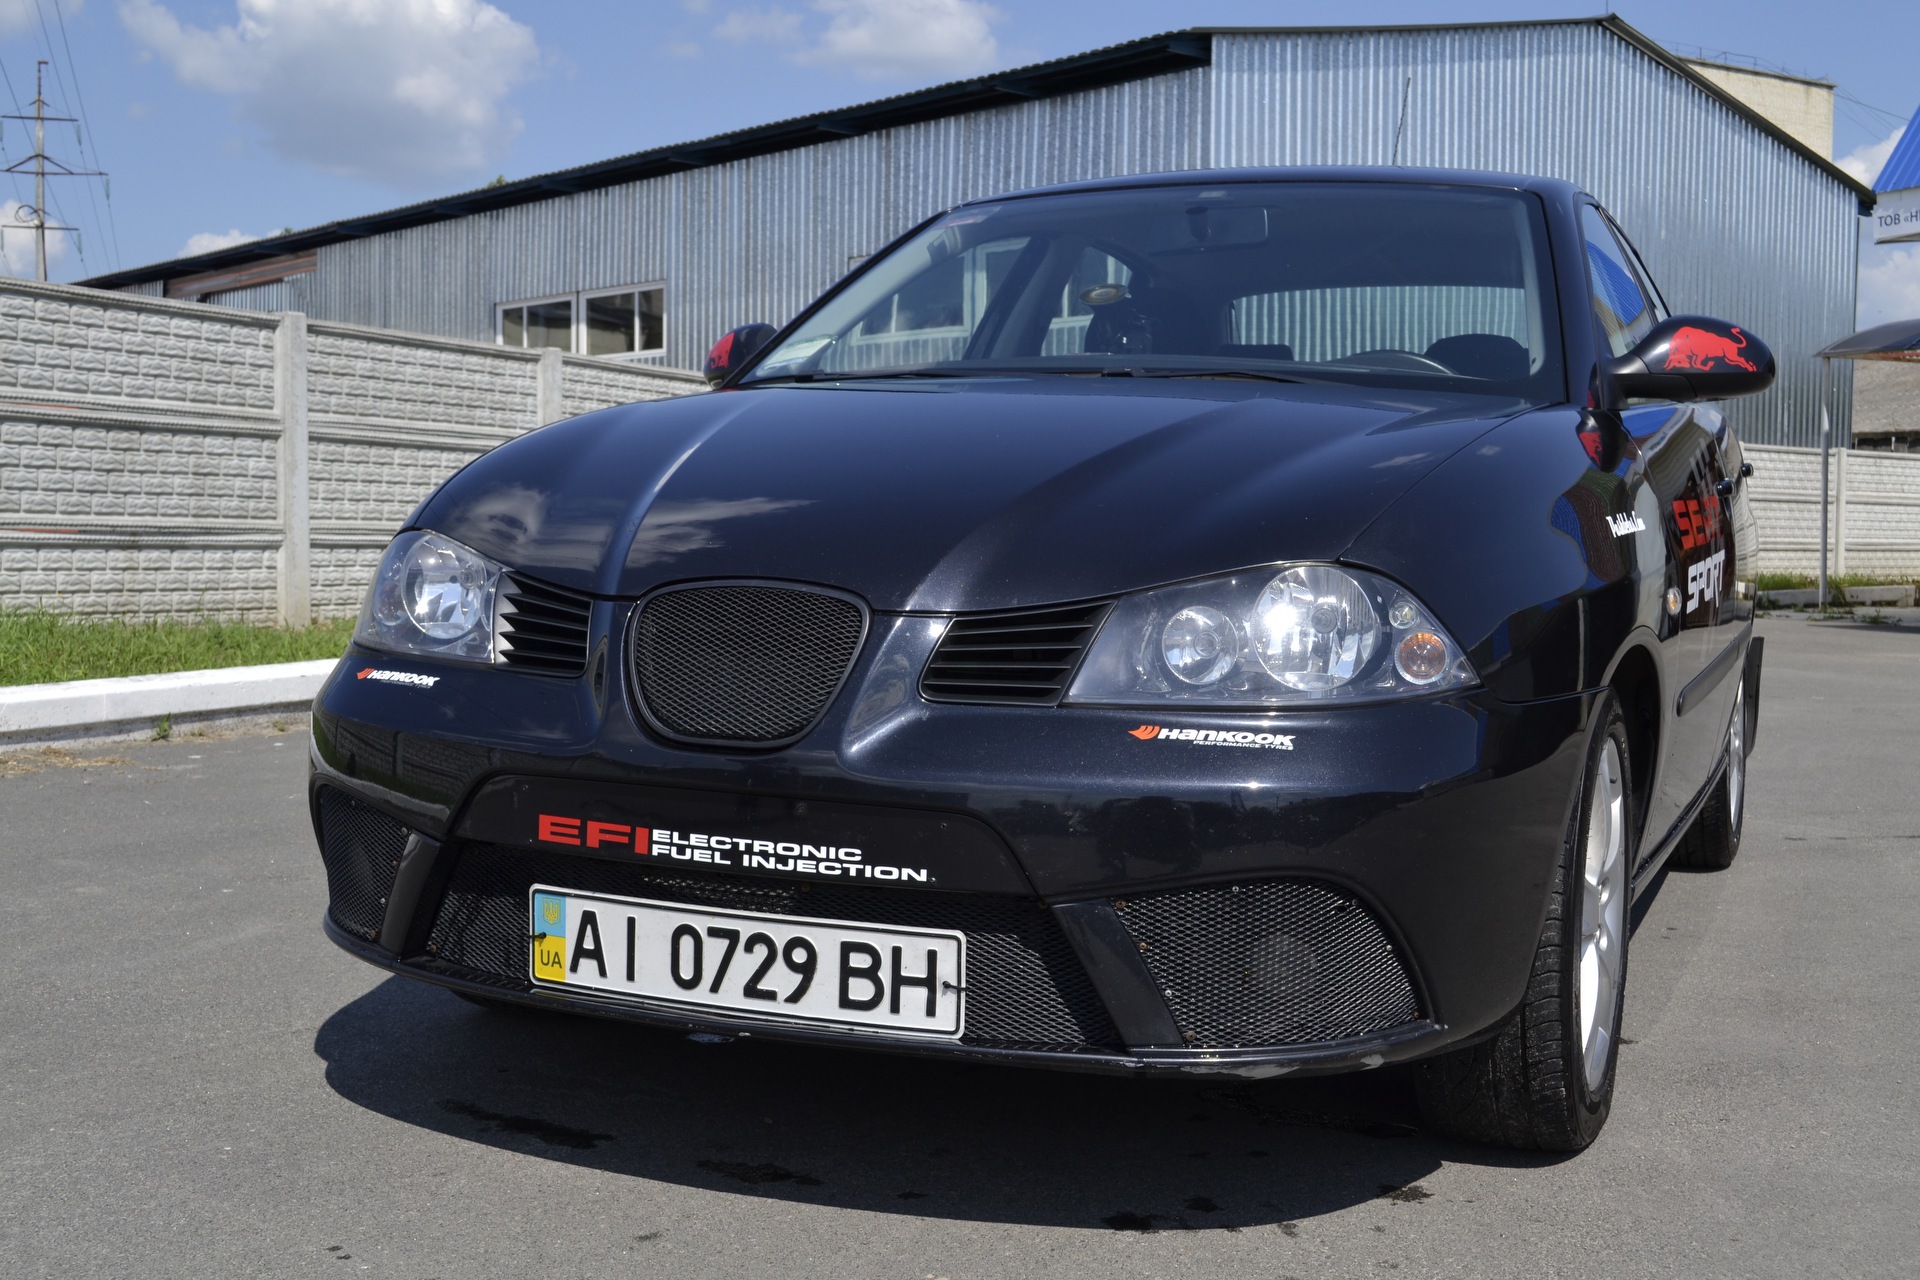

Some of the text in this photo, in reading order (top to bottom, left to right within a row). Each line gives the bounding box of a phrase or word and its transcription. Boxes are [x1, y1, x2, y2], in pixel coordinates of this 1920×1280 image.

[1878, 210, 1920, 227] ТОВ «Н
[1672, 494, 1723, 550] SEAT
[1686, 549, 1726, 614] SPORT
[1193, 740, 1261, 748] PERFORMANCE
[538, 814, 649, 855] EFI
[652, 829, 862, 862] ELECTRONIC
[651, 843, 928, 882] FUEL INJECTION
[540, 949, 563, 970] UA
[569, 910, 938, 1017] AI 0729 BH
